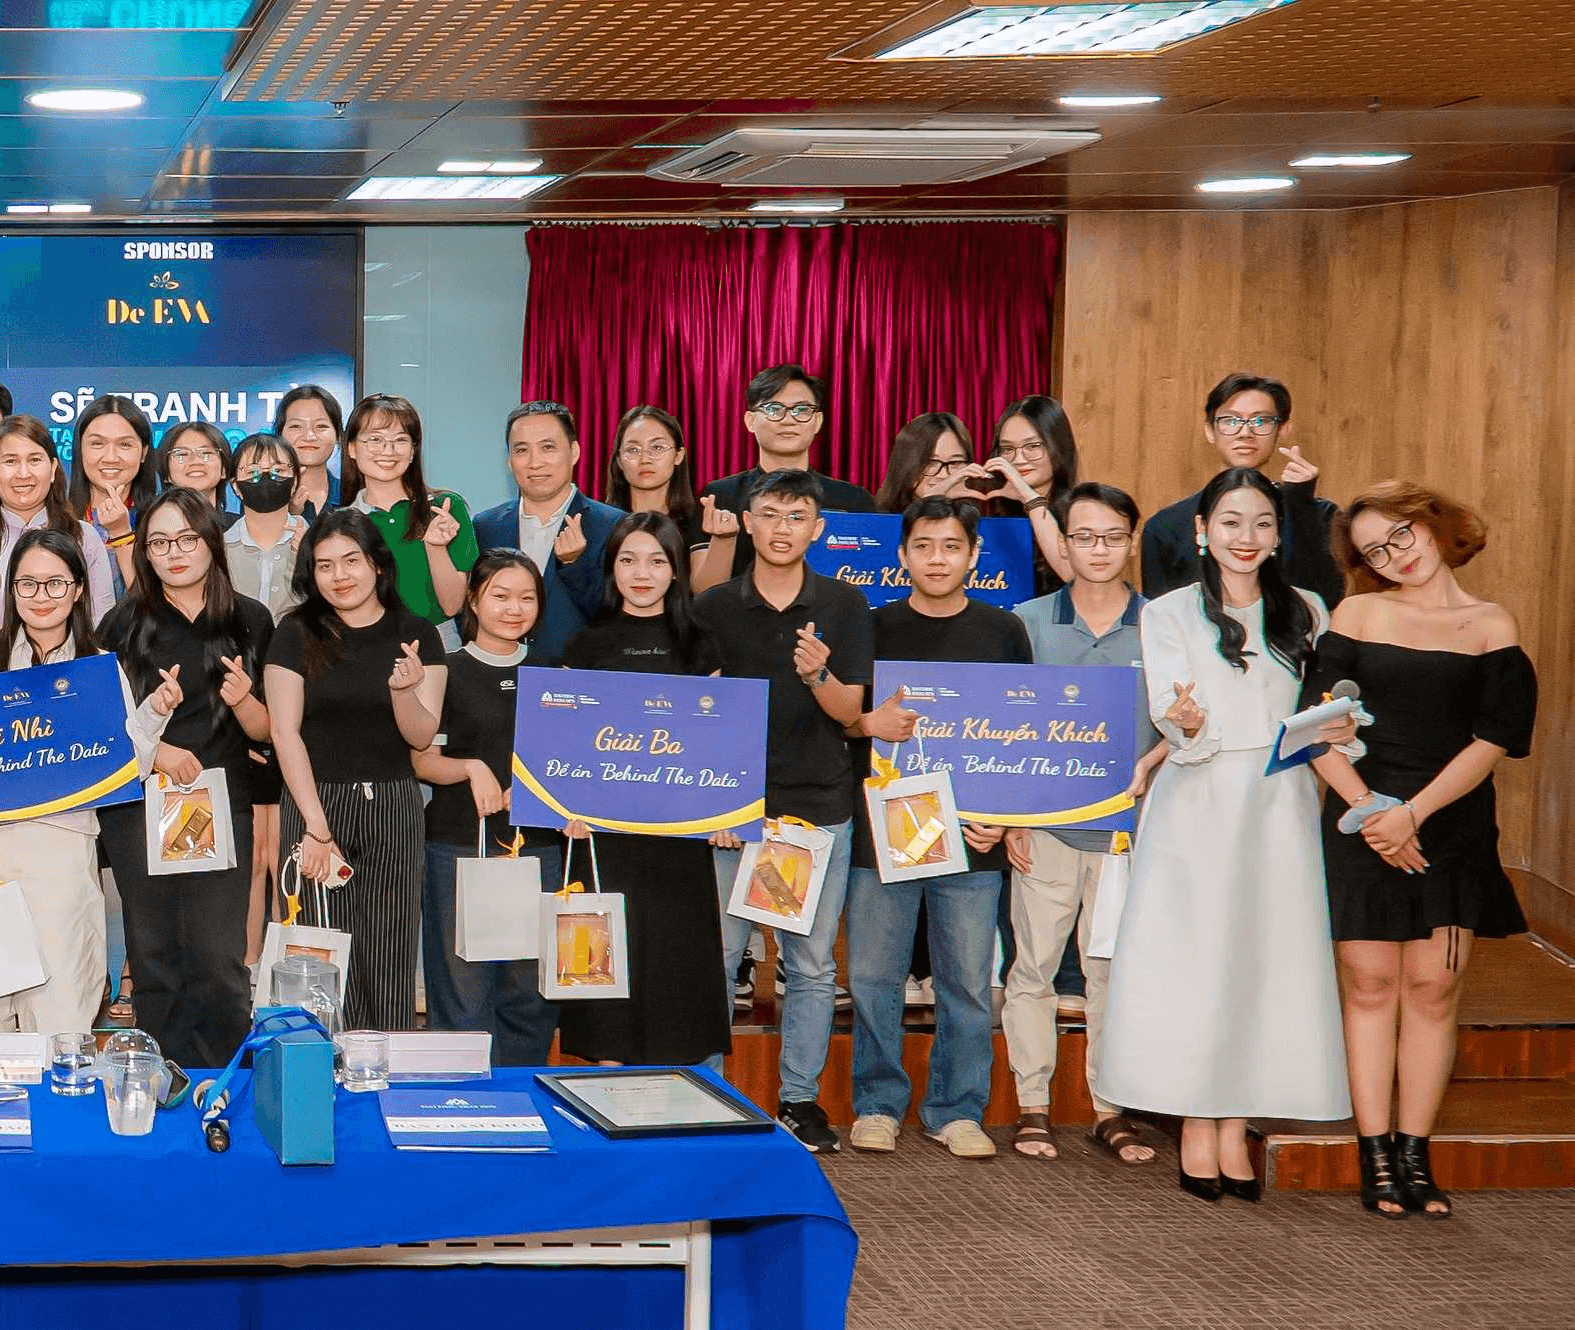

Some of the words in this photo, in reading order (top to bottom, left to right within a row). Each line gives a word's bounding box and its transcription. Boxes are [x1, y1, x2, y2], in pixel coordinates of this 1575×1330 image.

[123, 241, 214, 260] SPONSOR
[108, 299, 145, 324] De
[153, 299, 210, 324] EVA
[965, 568, 1009, 590] hích
[11, 716, 54, 743] Nhì
[594, 726, 644, 752] Giải
[649, 729, 685, 755] Ba
[912, 716, 956, 739] Giải
[1046, 720, 1110, 744] Khích
[36, 748, 66, 768] The
[932, 757, 955, 773] án
[1030, 757, 1061, 777] The
[545, 759, 569, 778] Đề
[571, 764, 593, 779] án
[665, 767, 695, 786] The
